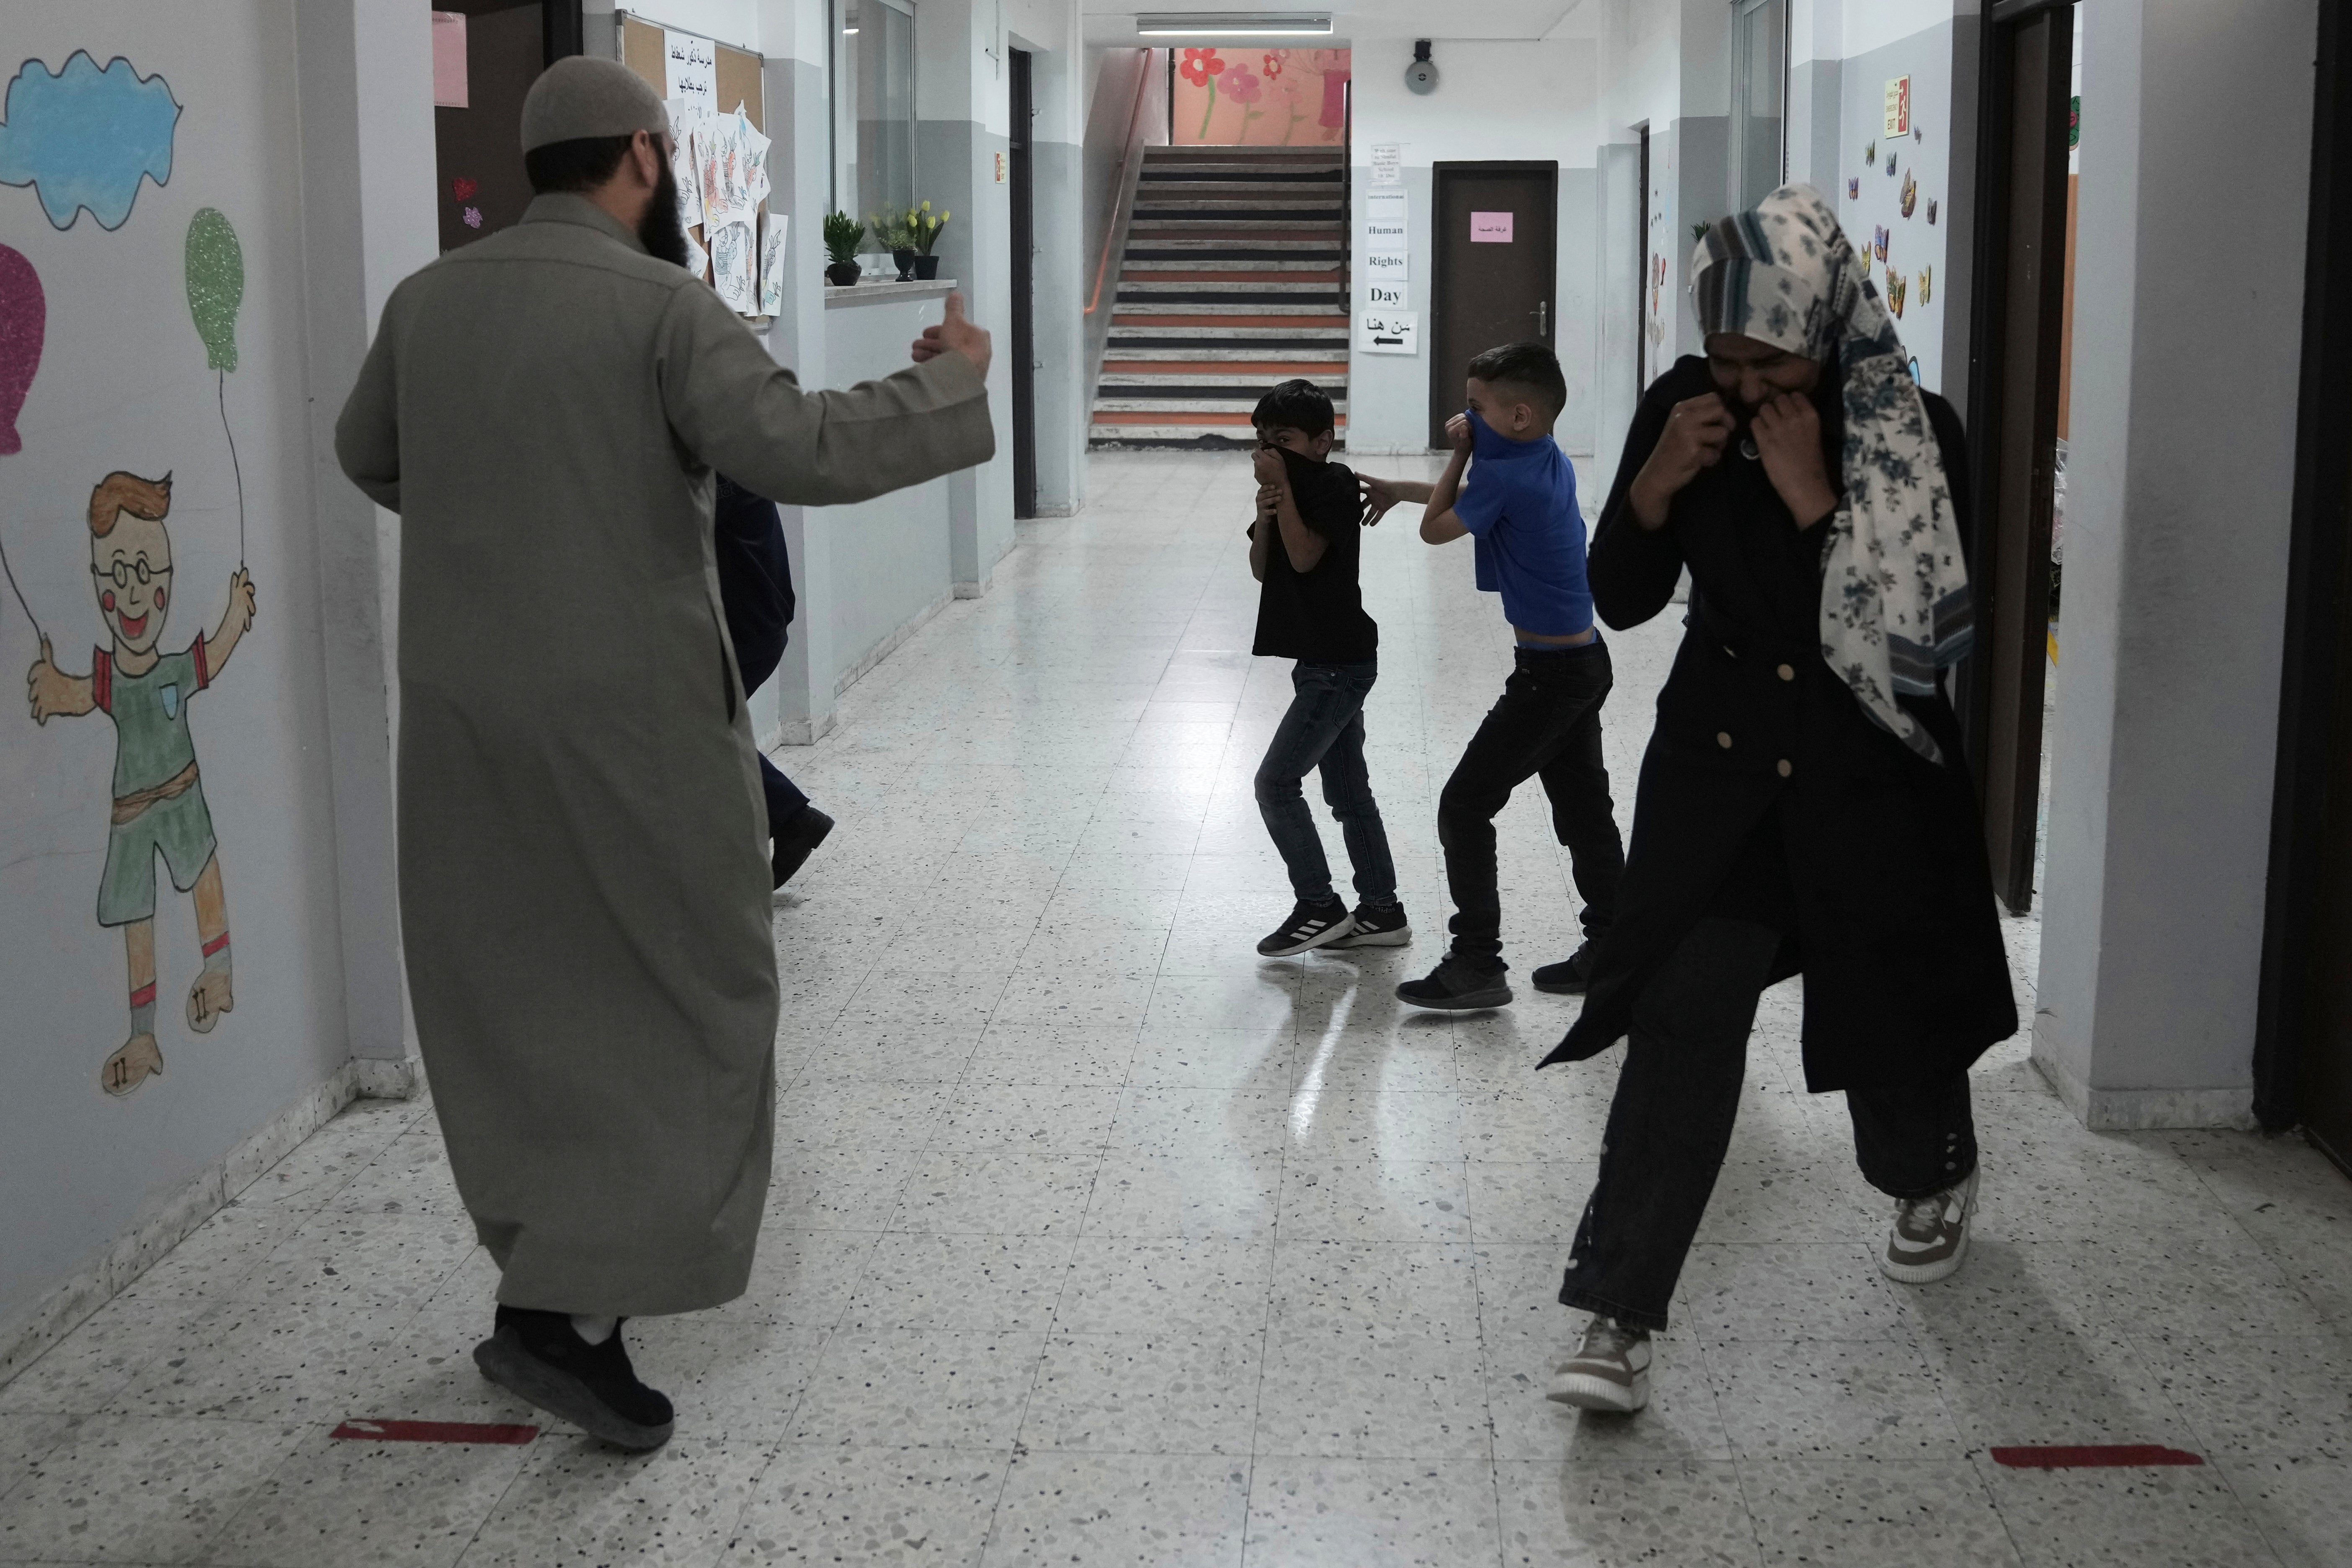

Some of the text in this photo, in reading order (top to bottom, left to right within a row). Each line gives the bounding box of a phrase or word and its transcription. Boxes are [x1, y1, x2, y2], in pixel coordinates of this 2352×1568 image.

[671, 44, 712, 68] مدرسة ذكور شعفاط
[696, 81, 707, 95] ترحب
[1369, 256, 1403, 268] Rights
[1371, 288, 1401, 305] Day
[1367, 318, 1384, 330] هنا
